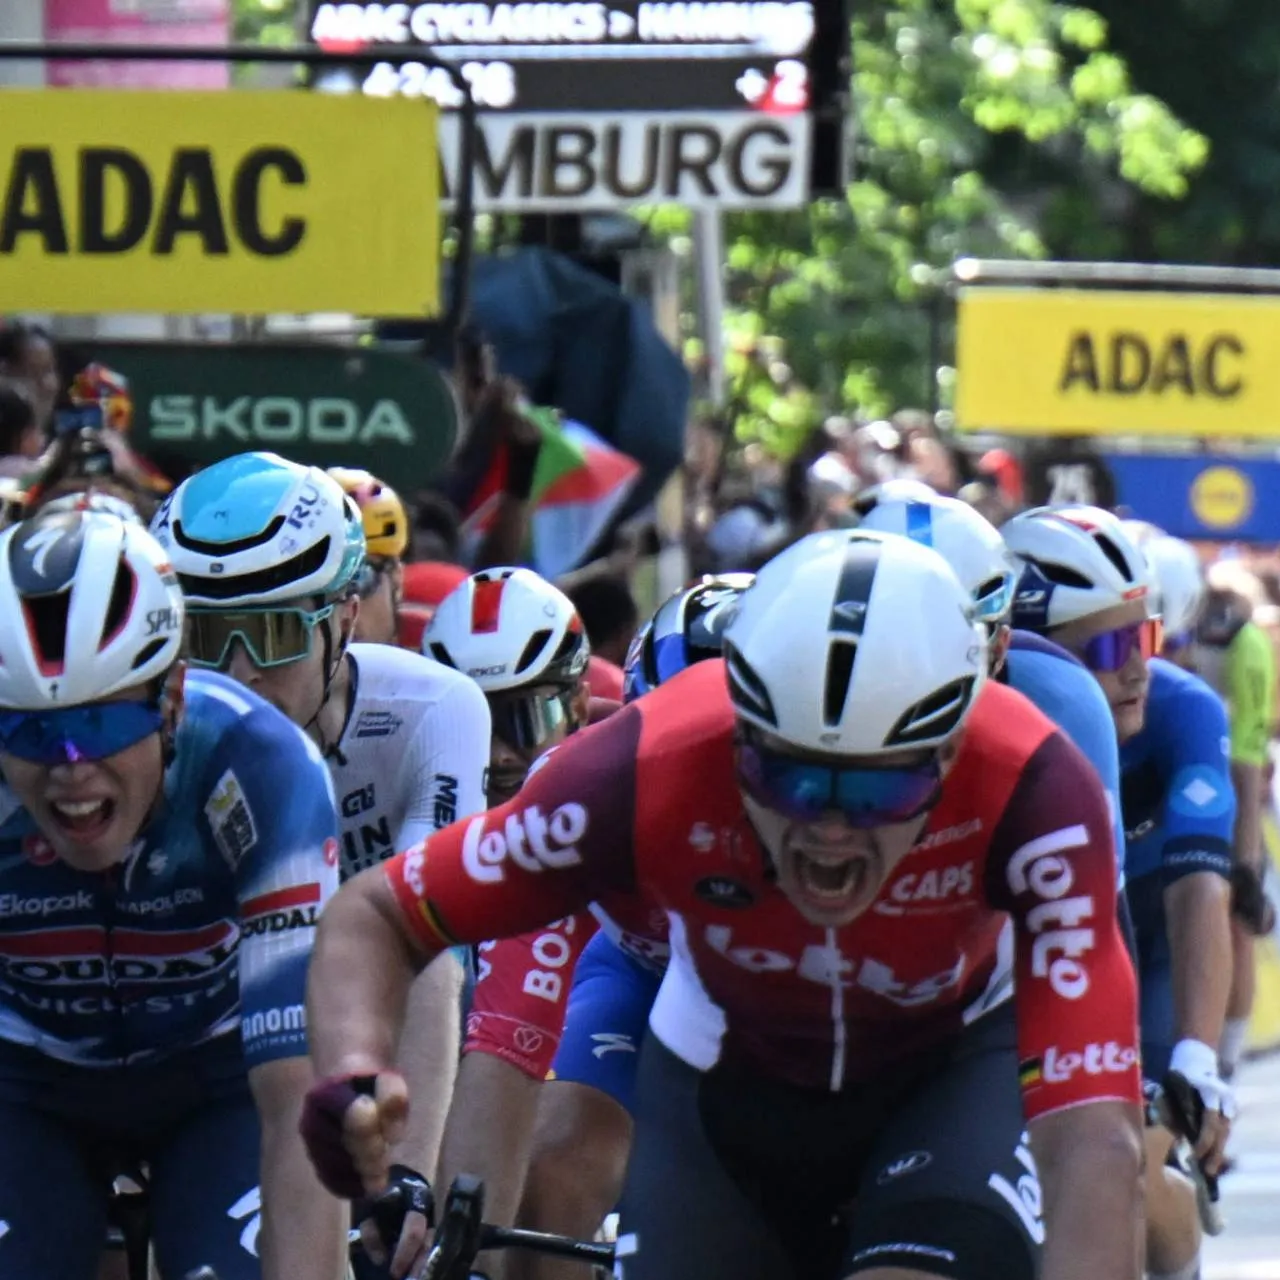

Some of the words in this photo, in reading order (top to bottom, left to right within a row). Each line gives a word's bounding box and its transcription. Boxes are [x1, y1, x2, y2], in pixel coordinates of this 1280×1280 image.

[441, 121, 793, 198] MBURG
[1, 145, 307, 257] ADAC
[1059, 330, 1247, 399] ADAC
[0, 889, 94, 917] Ekopak
[240, 906, 318, 939] OUDAL
[2, 944, 240, 981] OUDAL
